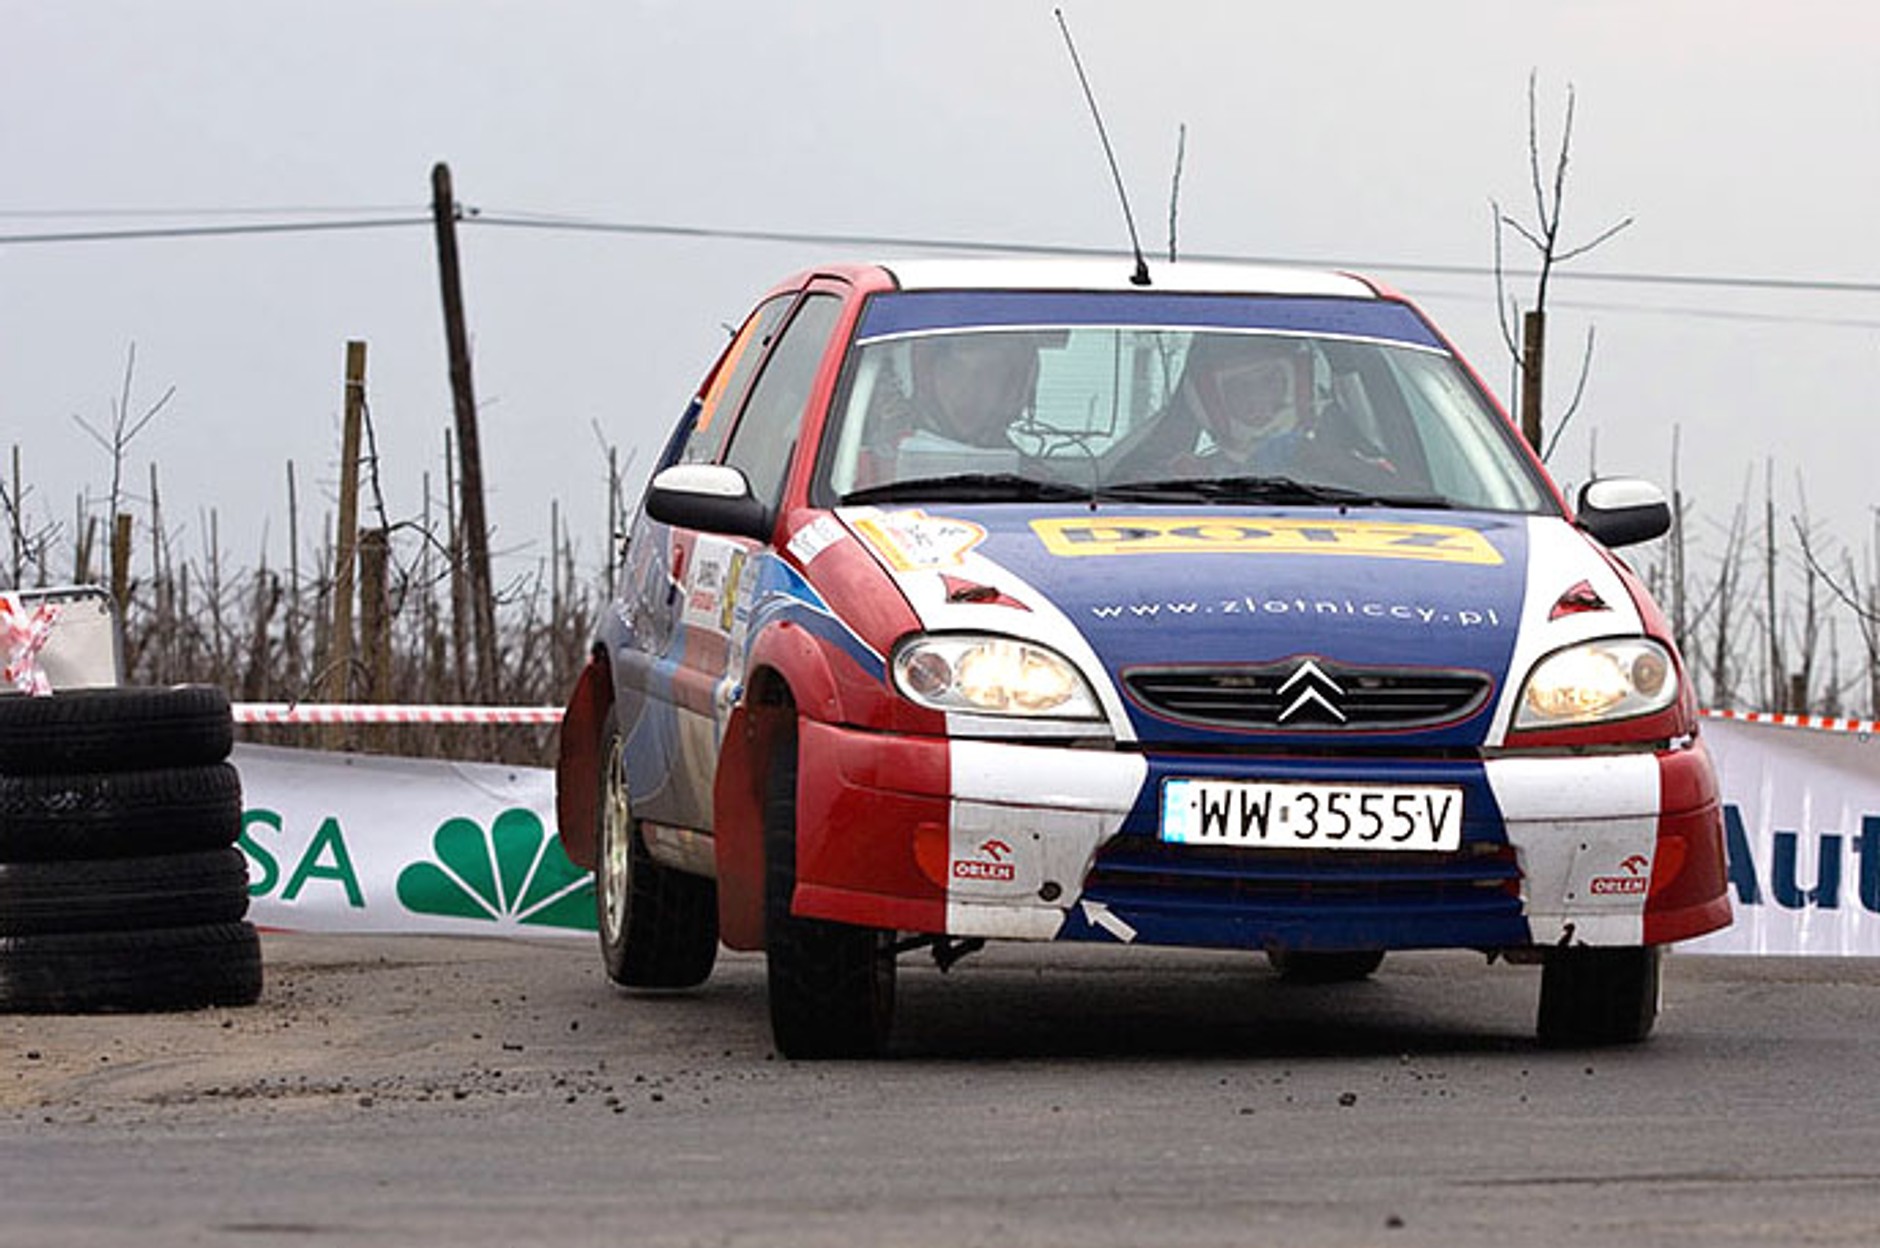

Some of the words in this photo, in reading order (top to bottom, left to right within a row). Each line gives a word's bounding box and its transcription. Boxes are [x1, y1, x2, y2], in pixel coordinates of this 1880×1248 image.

[1059, 524, 1473, 550] DOTZ
[1092, 597, 1499, 627] www.zlotniccy.pl
[1200, 788, 1272, 838] WW
[1294, 791, 1452, 843] 3555V
